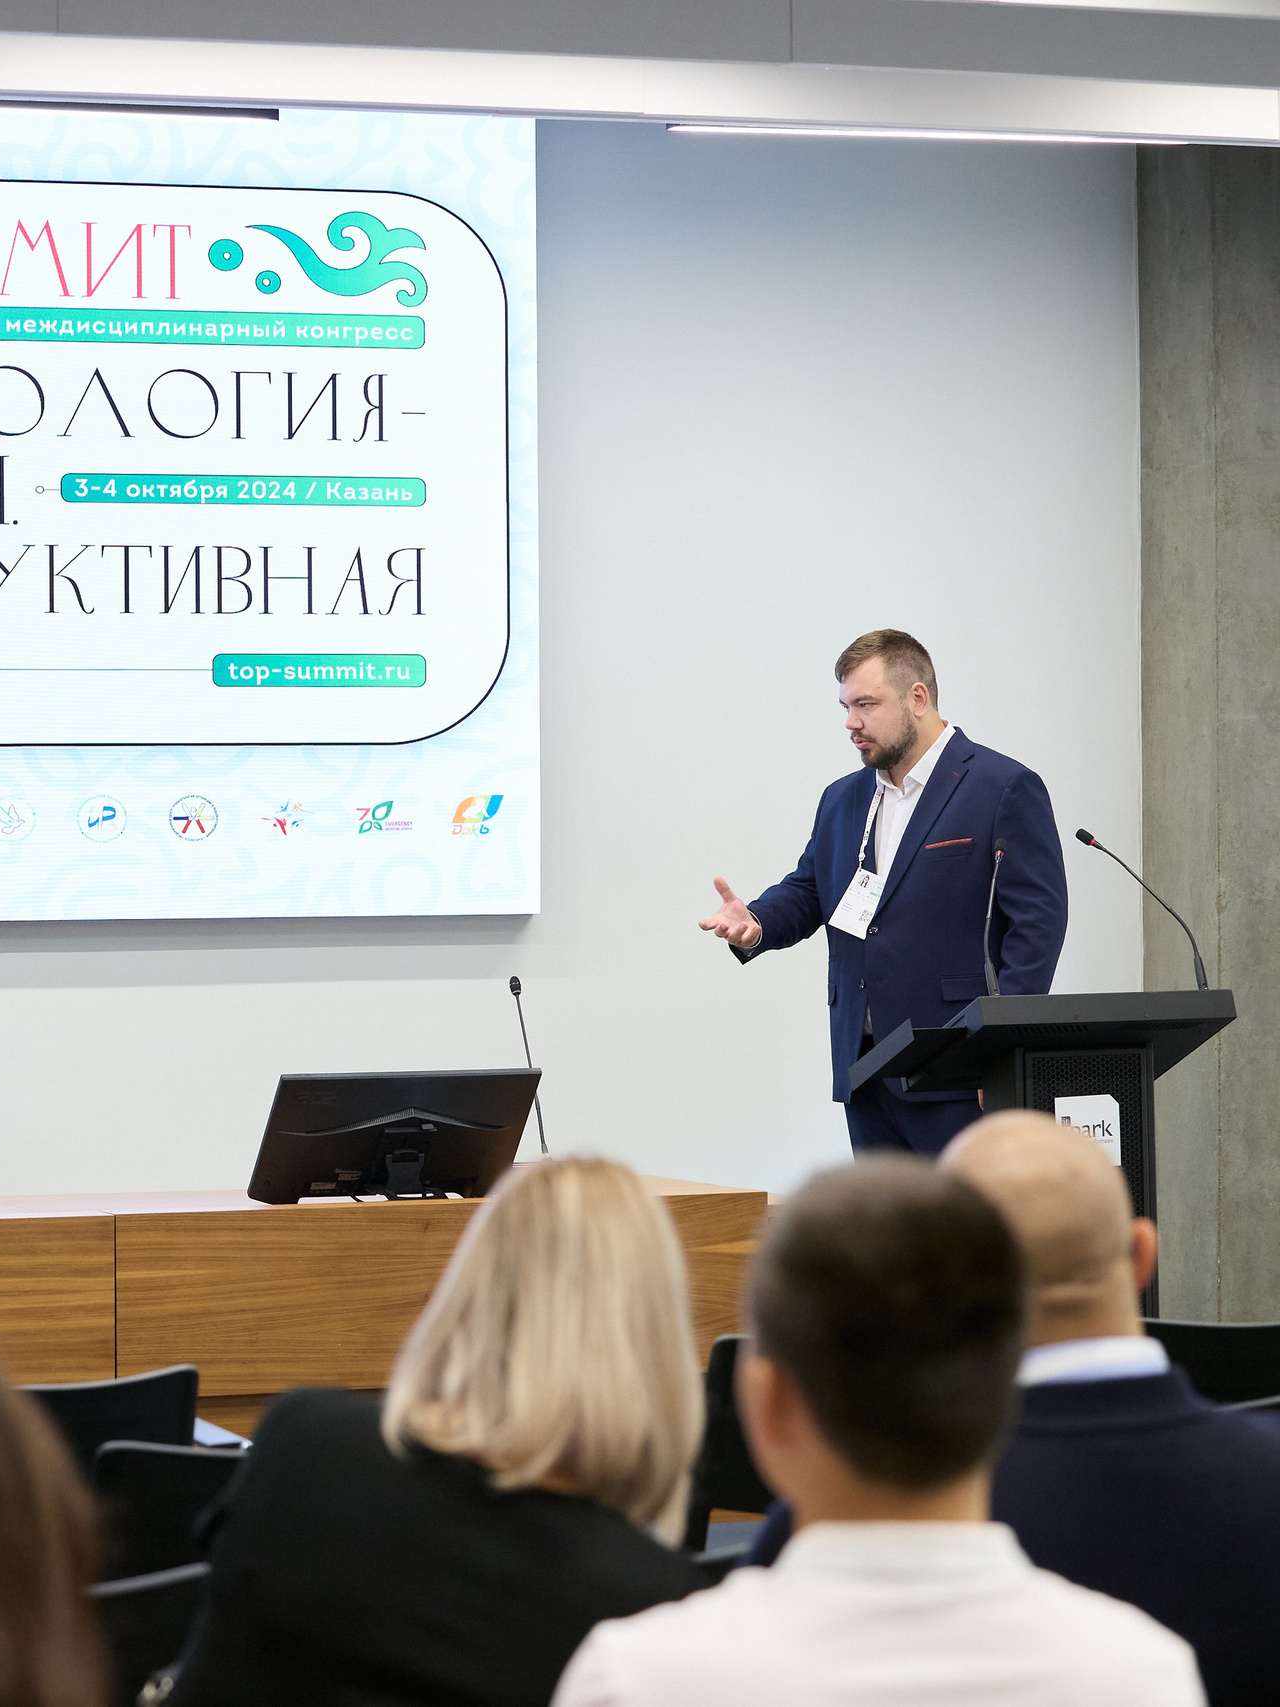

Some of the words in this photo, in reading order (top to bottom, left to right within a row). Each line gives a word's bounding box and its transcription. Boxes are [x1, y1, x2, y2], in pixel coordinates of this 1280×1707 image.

[6, 315, 286, 342] междисциплинарный
[296, 322, 415, 345] конгресс
[74, 478, 117, 498] 3-4
[126, 479, 228, 504] октября
[237, 480, 297, 500] 2024
[326, 481, 413, 501] Казань
[228, 661, 411, 685] top-summit.ru
